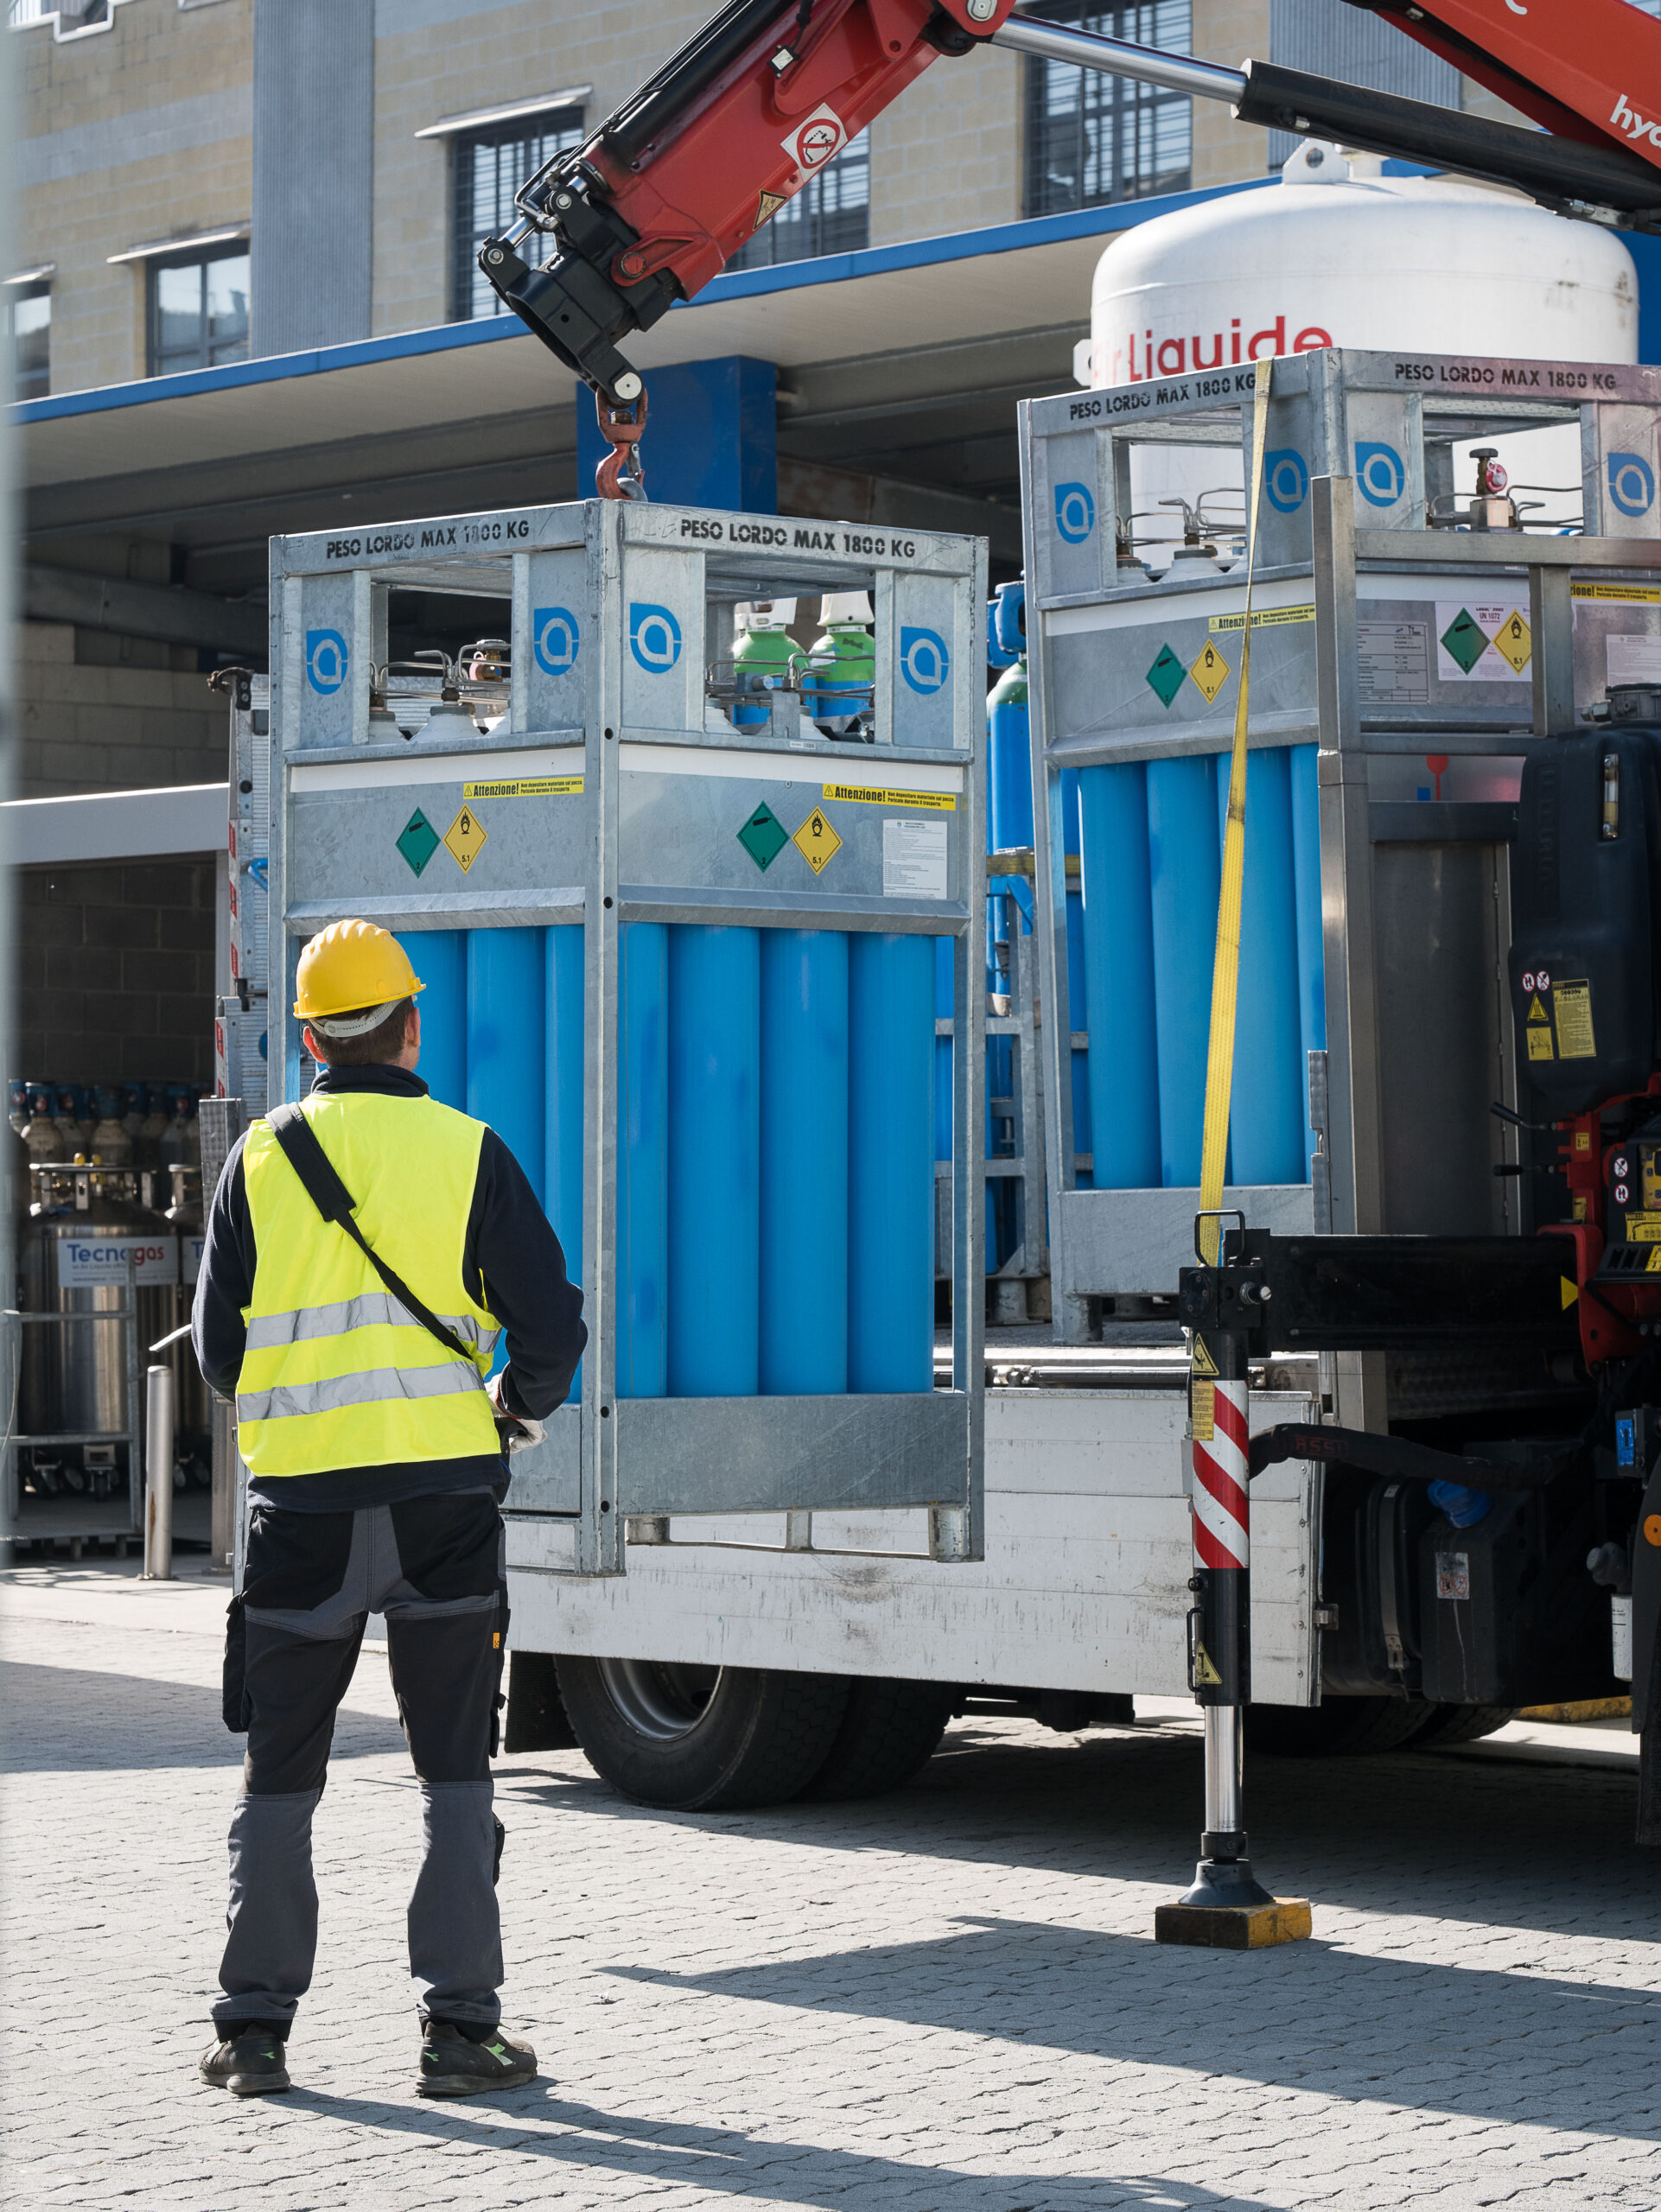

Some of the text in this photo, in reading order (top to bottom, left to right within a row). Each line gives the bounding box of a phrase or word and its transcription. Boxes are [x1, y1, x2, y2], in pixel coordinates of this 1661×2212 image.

[1130, 315, 1333, 382] Liquide
[1395, 363, 1616, 390] PESO LORDO MAX 1800 KG
[1069, 372, 1256, 421] PESO LORDO MAX 1800 KG
[327, 538, 361, 560] PESO
[366, 532, 416, 554] LORDO
[420, 527, 456, 548] MAX
[506, 520, 529, 539] KG
[681, 518, 915, 558] PESO LORDO MAX 1800 KG
[1219, 613, 1261, 629] Attenzine!
[474, 783, 519, 797] Attenzione!
[835, 785, 886, 802] Attenzione!
